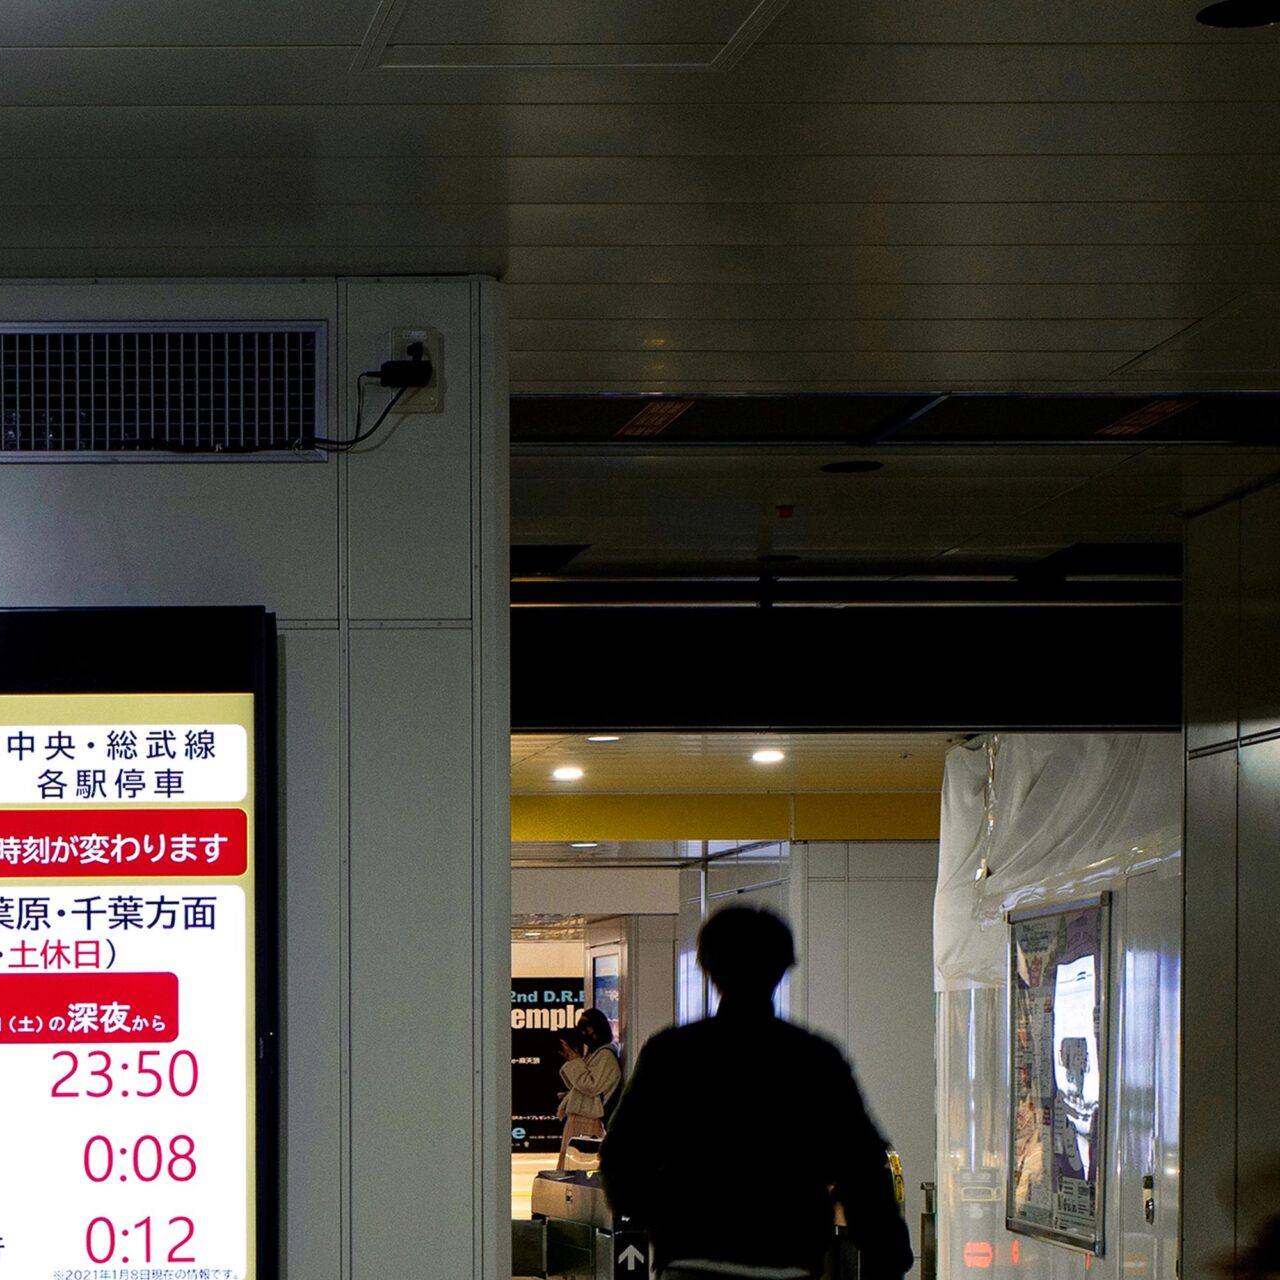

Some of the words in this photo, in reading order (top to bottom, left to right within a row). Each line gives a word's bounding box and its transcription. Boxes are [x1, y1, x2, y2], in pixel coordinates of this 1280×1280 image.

[38, 769, 184, 799] 各駅停車
[52, 1050, 198, 1097] 23:50
[84, 1135, 196, 1182] 0:08
[86, 1216, 195, 1263] 0:12
